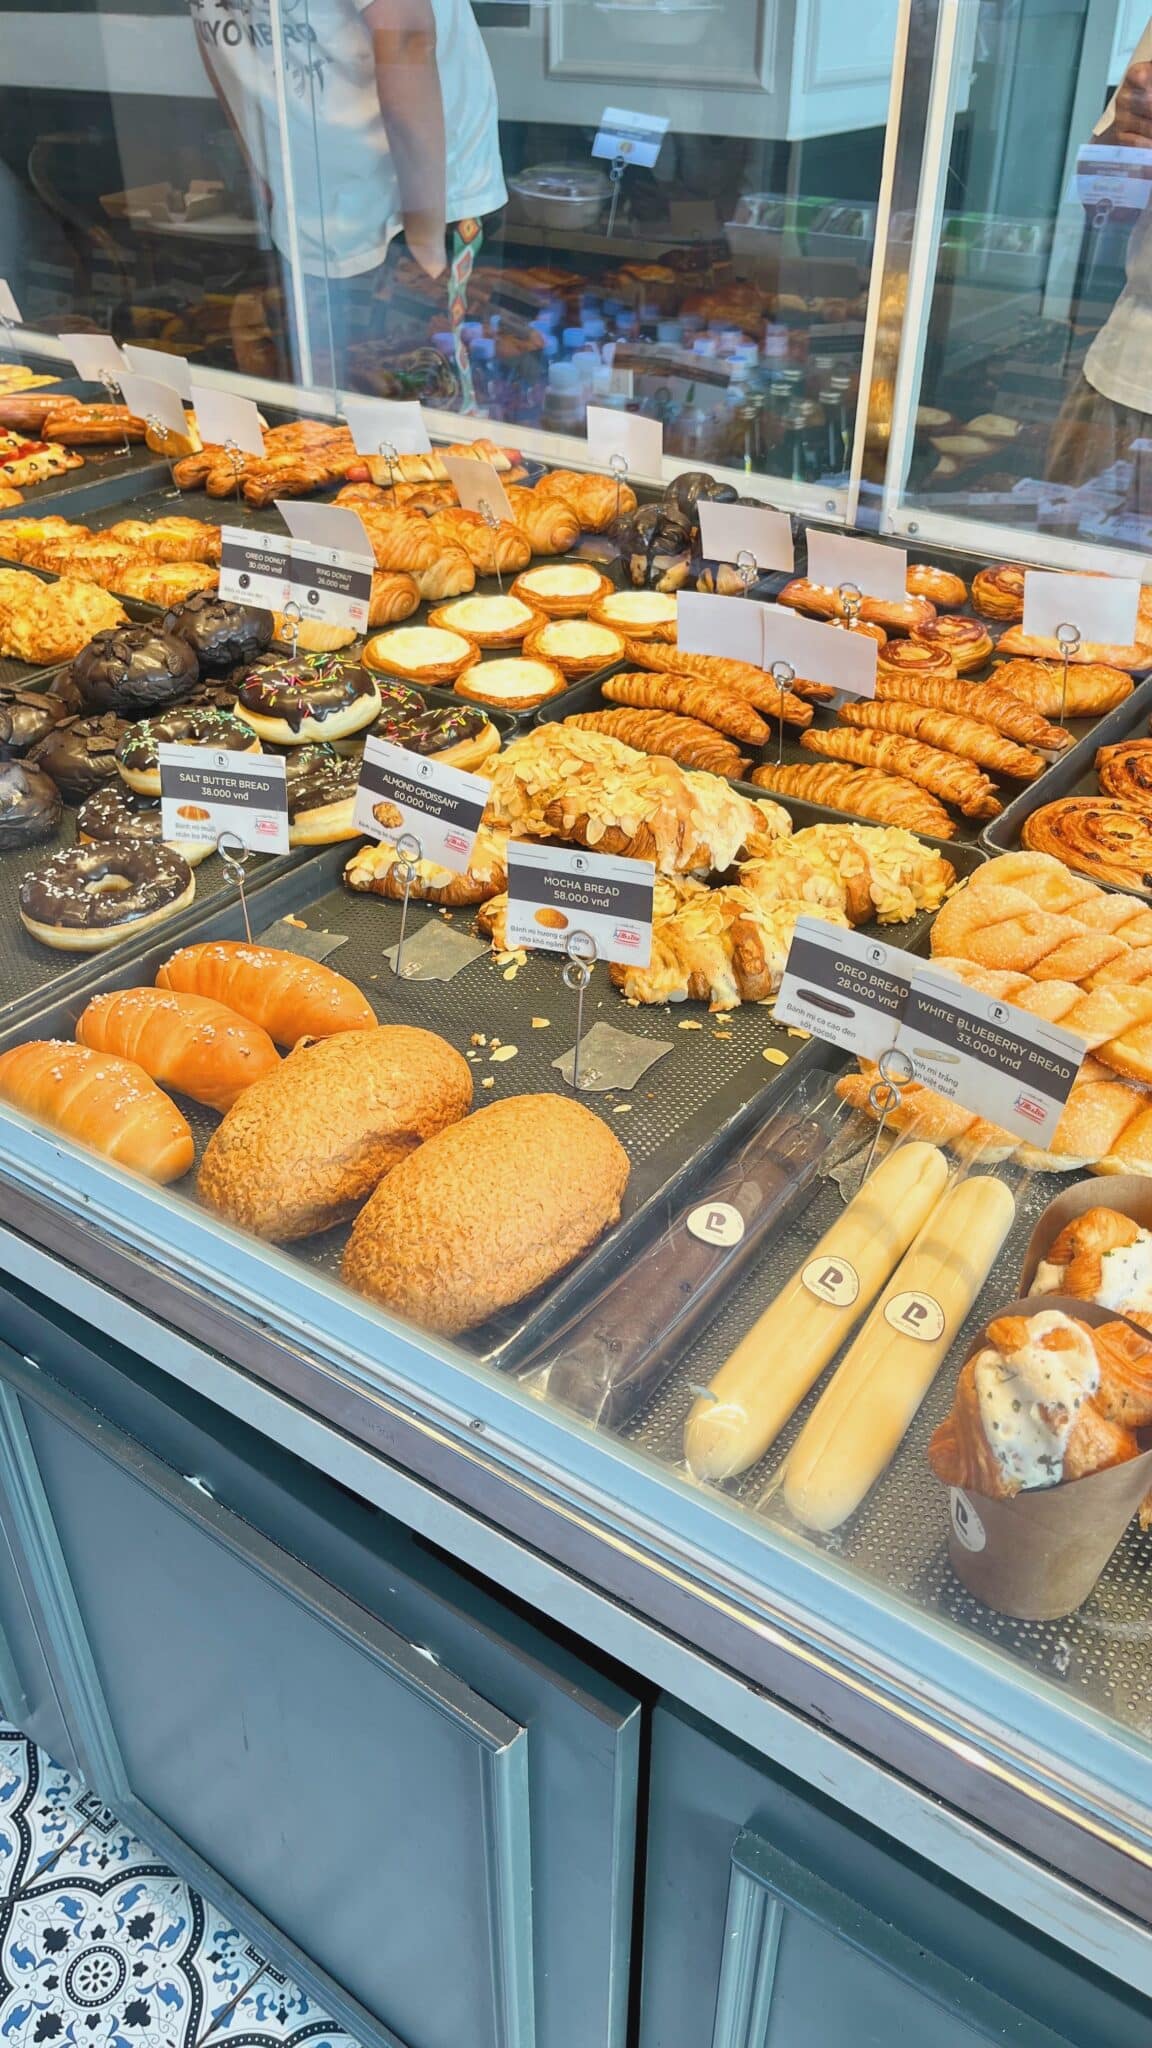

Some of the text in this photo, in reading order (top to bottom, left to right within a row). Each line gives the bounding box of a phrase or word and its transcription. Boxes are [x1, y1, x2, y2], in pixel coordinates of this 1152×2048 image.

[179, 773, 270, 792] SALT BUTTER BREAD
[201, 786, 232, 799] 38.000
[382, 774, 459, 810] ALMOND CROISSANT
[394, 790, 424, 808] 60.000
[544, 876, 620, 897] MOCHA BREAD
[554, 890, 589, 905] 58.000
[834, 961, 909, 999] OREO BREAD
[836, 976, 876, 999] 28.000
[917, 999, 1070, 1079] WHITE BLUEBERRY BREAD
[956, 1032, 997, 1058] 33.000
